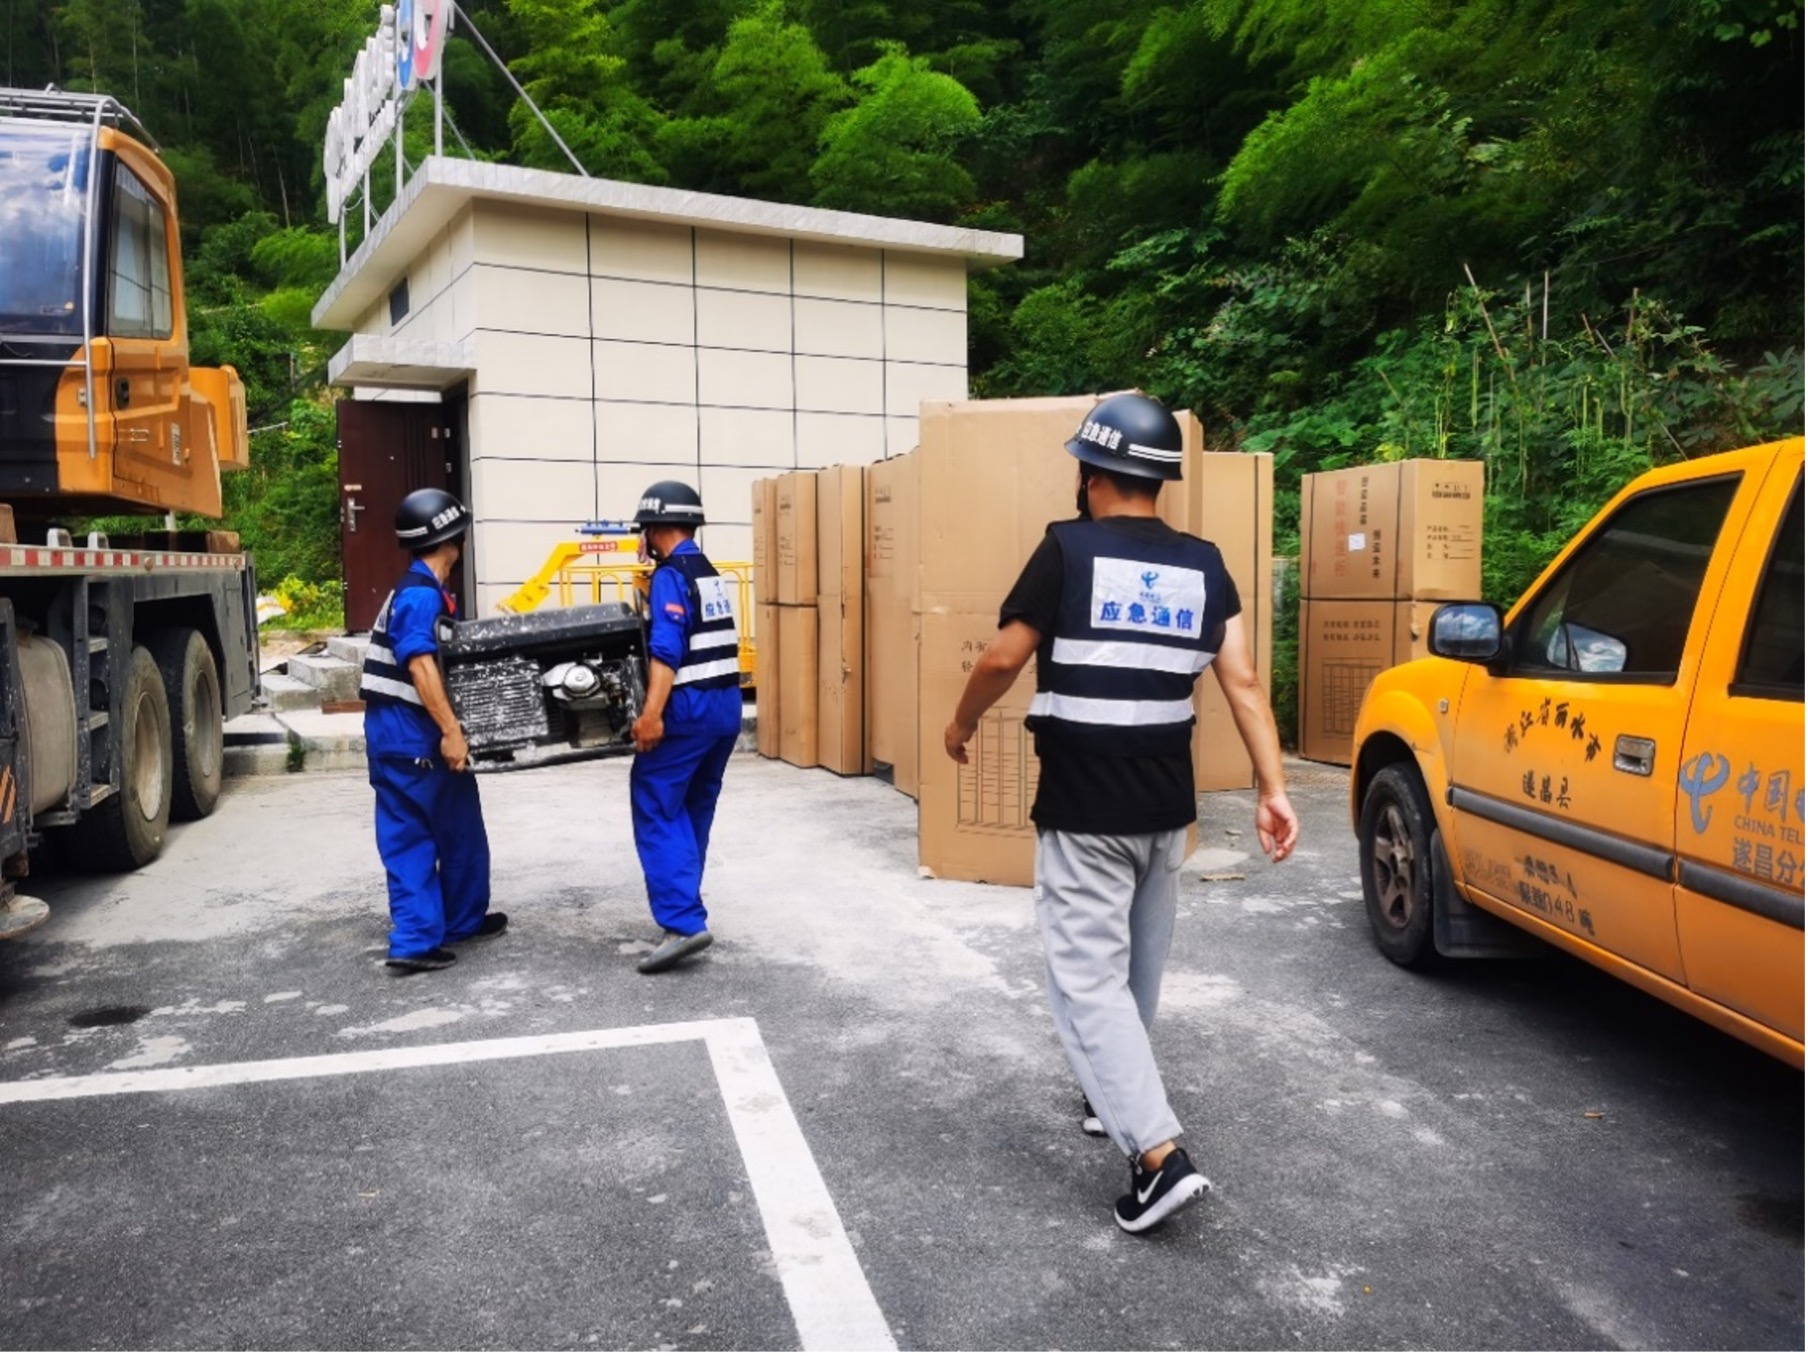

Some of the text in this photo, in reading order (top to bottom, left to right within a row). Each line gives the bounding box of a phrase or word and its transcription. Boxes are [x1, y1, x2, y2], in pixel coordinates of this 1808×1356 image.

[1081, 420, 1123, 450] 应急通信
[1100, 601, 1194, 631] 应急通信
[1734, 815, 1775, 838] CHINA
